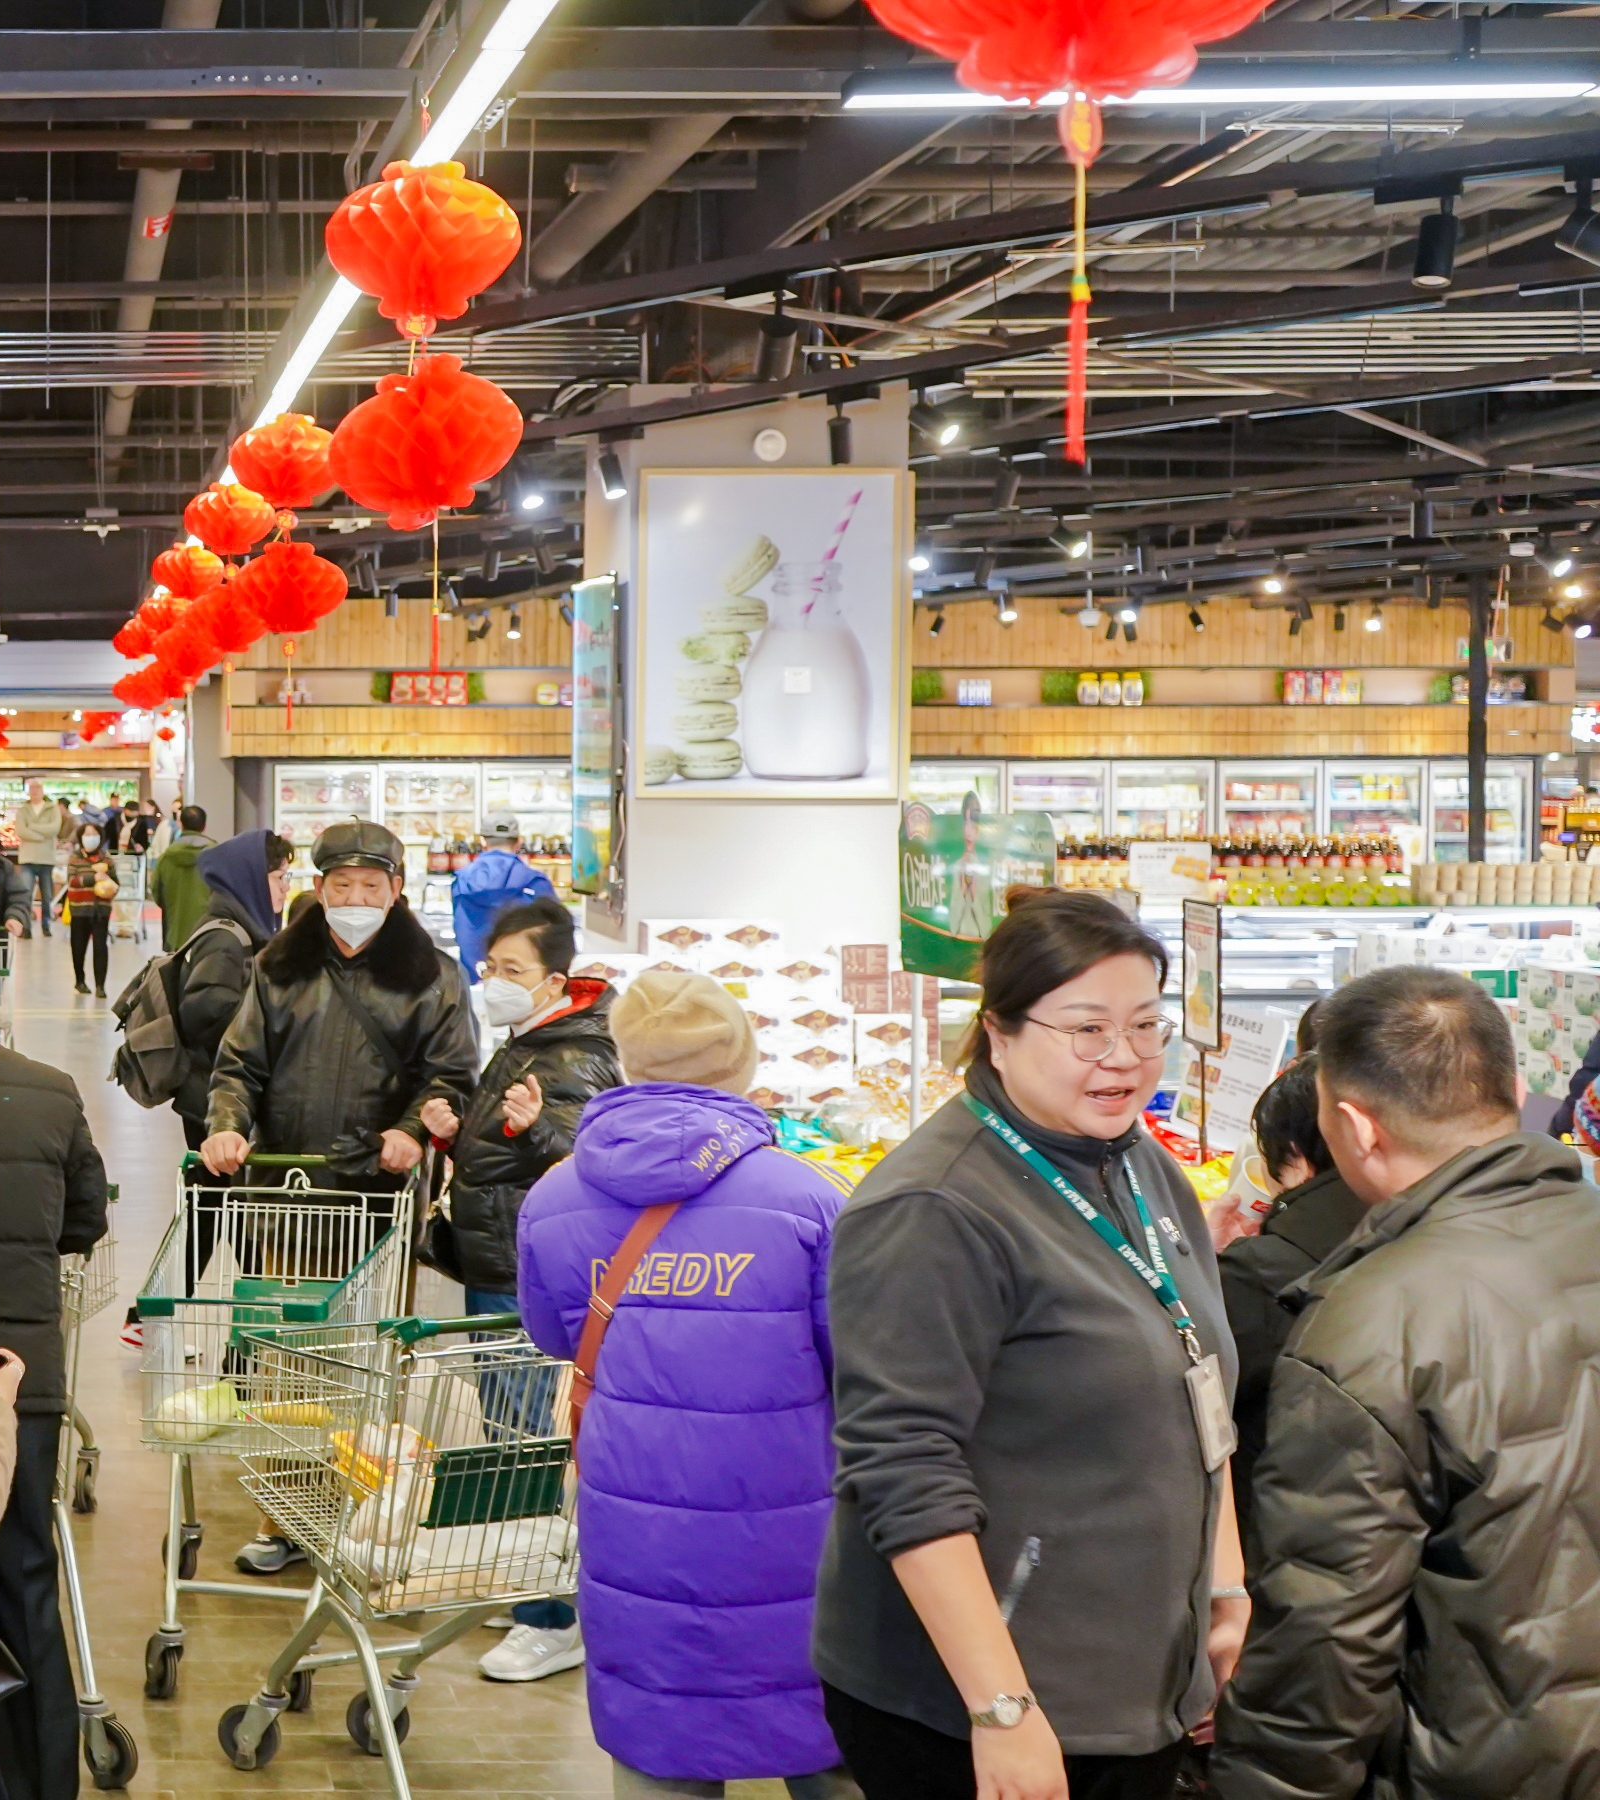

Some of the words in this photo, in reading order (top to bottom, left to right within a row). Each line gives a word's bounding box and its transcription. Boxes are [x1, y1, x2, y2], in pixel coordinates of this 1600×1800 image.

[691, 1138, 722, 1173] WHO
[716, 1118, 732, 1140] IS
[531, 1643, 548, 1656] N
